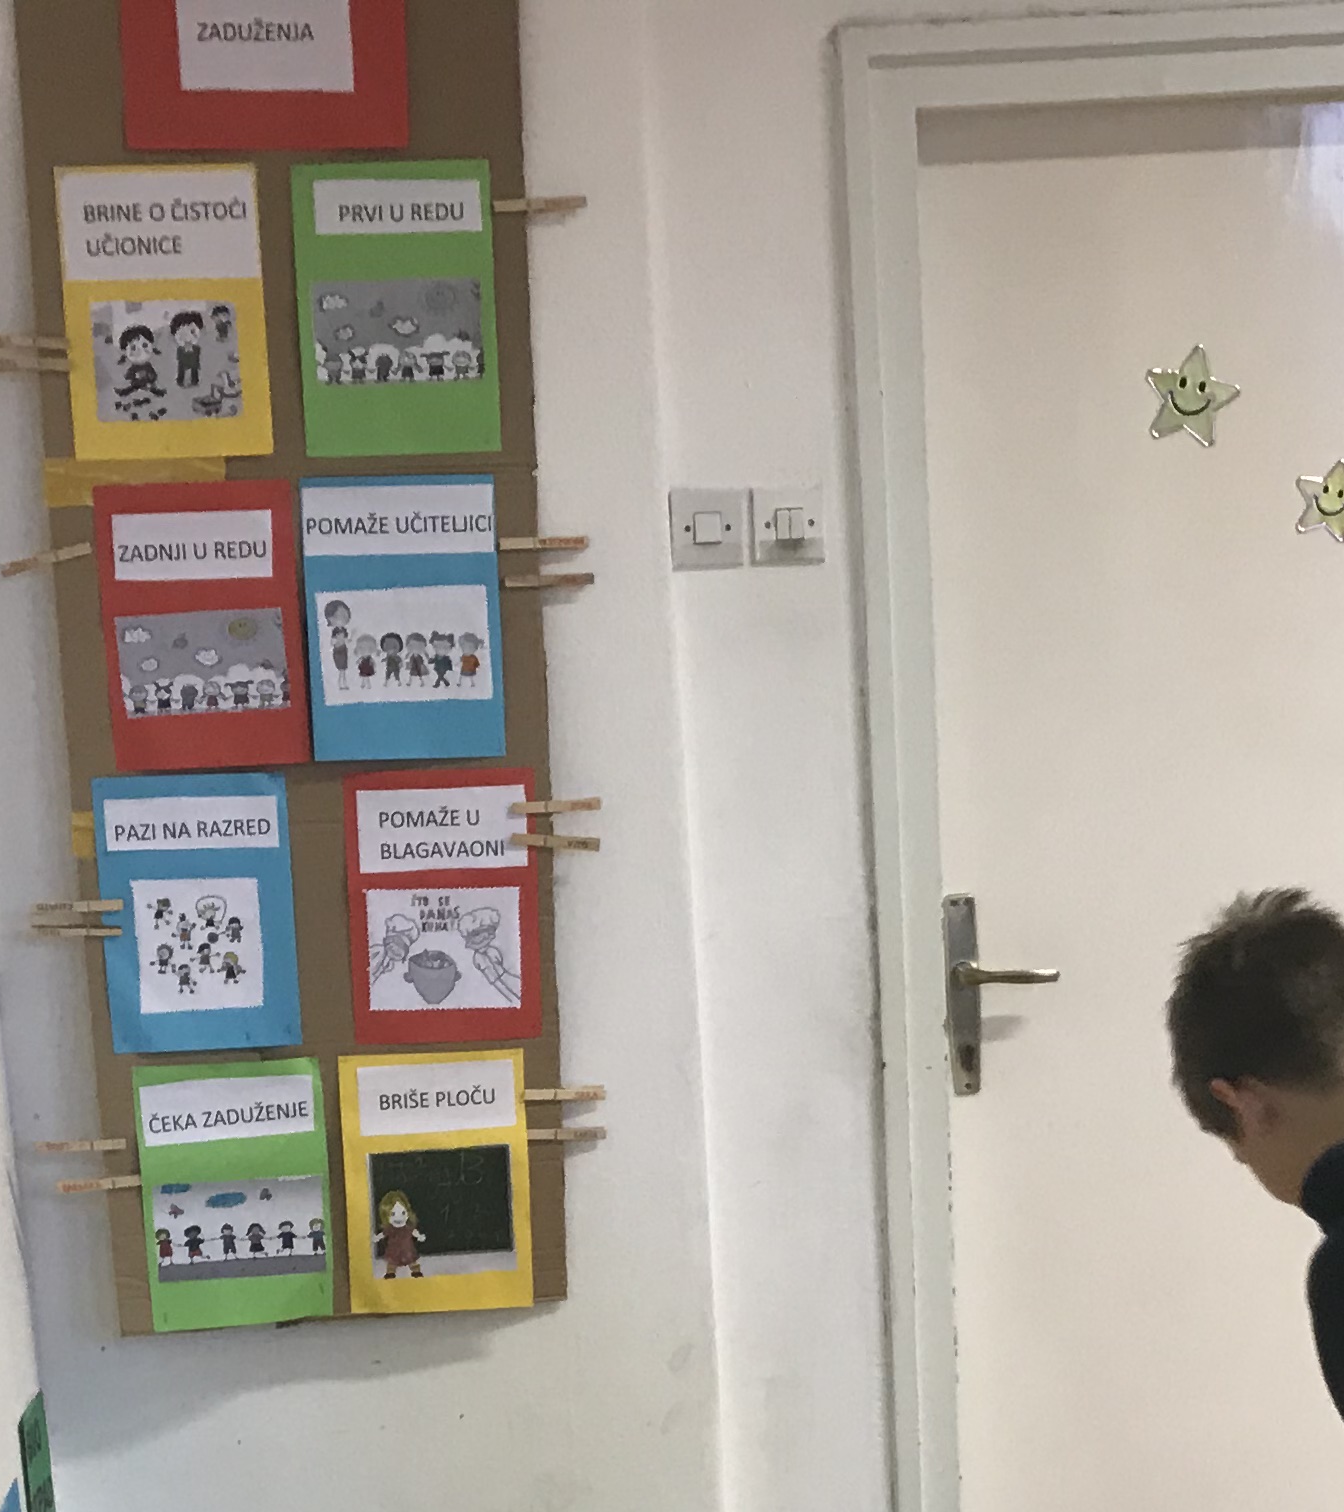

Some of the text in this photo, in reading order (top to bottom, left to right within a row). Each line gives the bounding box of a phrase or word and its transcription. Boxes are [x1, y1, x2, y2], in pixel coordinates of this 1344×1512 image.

[197, 17, 314, 42] ZADUŽENJA
[83, 202, 142, 223] BRINE
[149, 203, 165, 222] O
[338, 202, 464, 222] PRVI U REDU
[86, 232, 182, 257] UČIONICE
[306, 511, 494, 535] POMAŽE UČITELJICI
[118, 540, 267, 562] ZADNJI U REDU
[378, 806, 481, 829] POMAŽE U
[114, 818, 271, 843] PAZI NA RAZRED
[380, 840, 505, 861] BLAGAVAONI
[379, 1085, 496, 1111] BRIŠE PLOČU
[149, 1100, 309, 1134] ČEKA ZADUŽENJE
